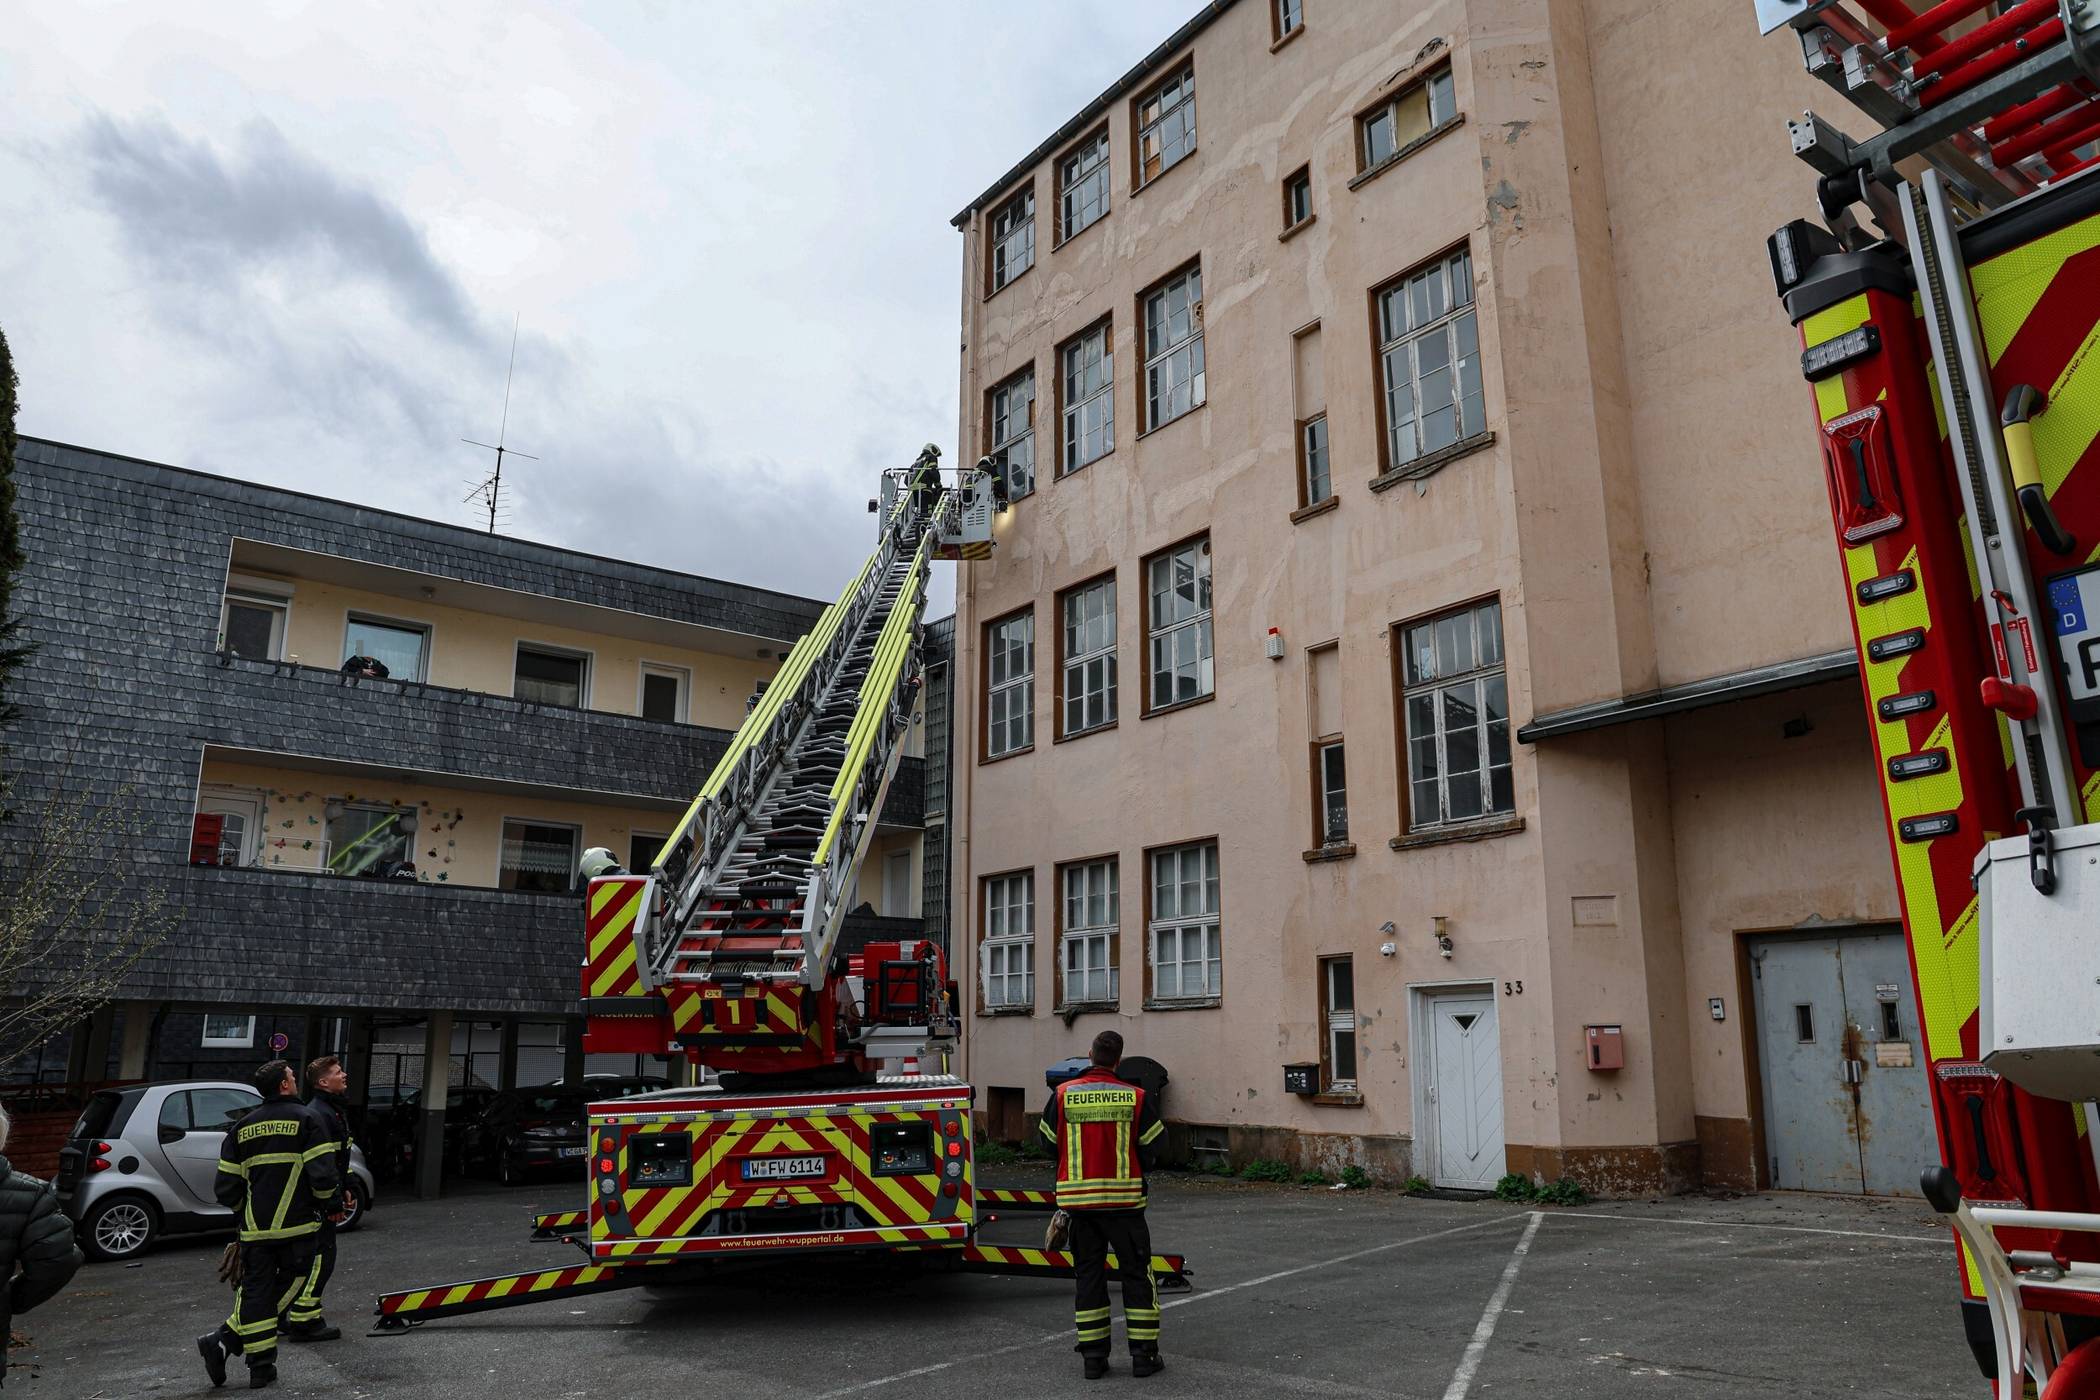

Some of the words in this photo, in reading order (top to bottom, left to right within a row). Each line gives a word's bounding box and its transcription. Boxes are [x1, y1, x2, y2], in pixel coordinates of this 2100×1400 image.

[2063, 613, 2077, 627] D
[1504, 980, 1523, 997] 33
[726, 999, 741, 1025] 1
[1067, 1092, 1134, 1105] FEUERWEHR
[238, 1123, 297, 1140] FEUERWEHR
[751, 1162, 759, 1175] W
[768, 1160, 786, 1175] FW
[789, 1159, 822, 1174] 6114
[719, 1233, 845, 1249] www.feuerwehr-wuppertal.de
